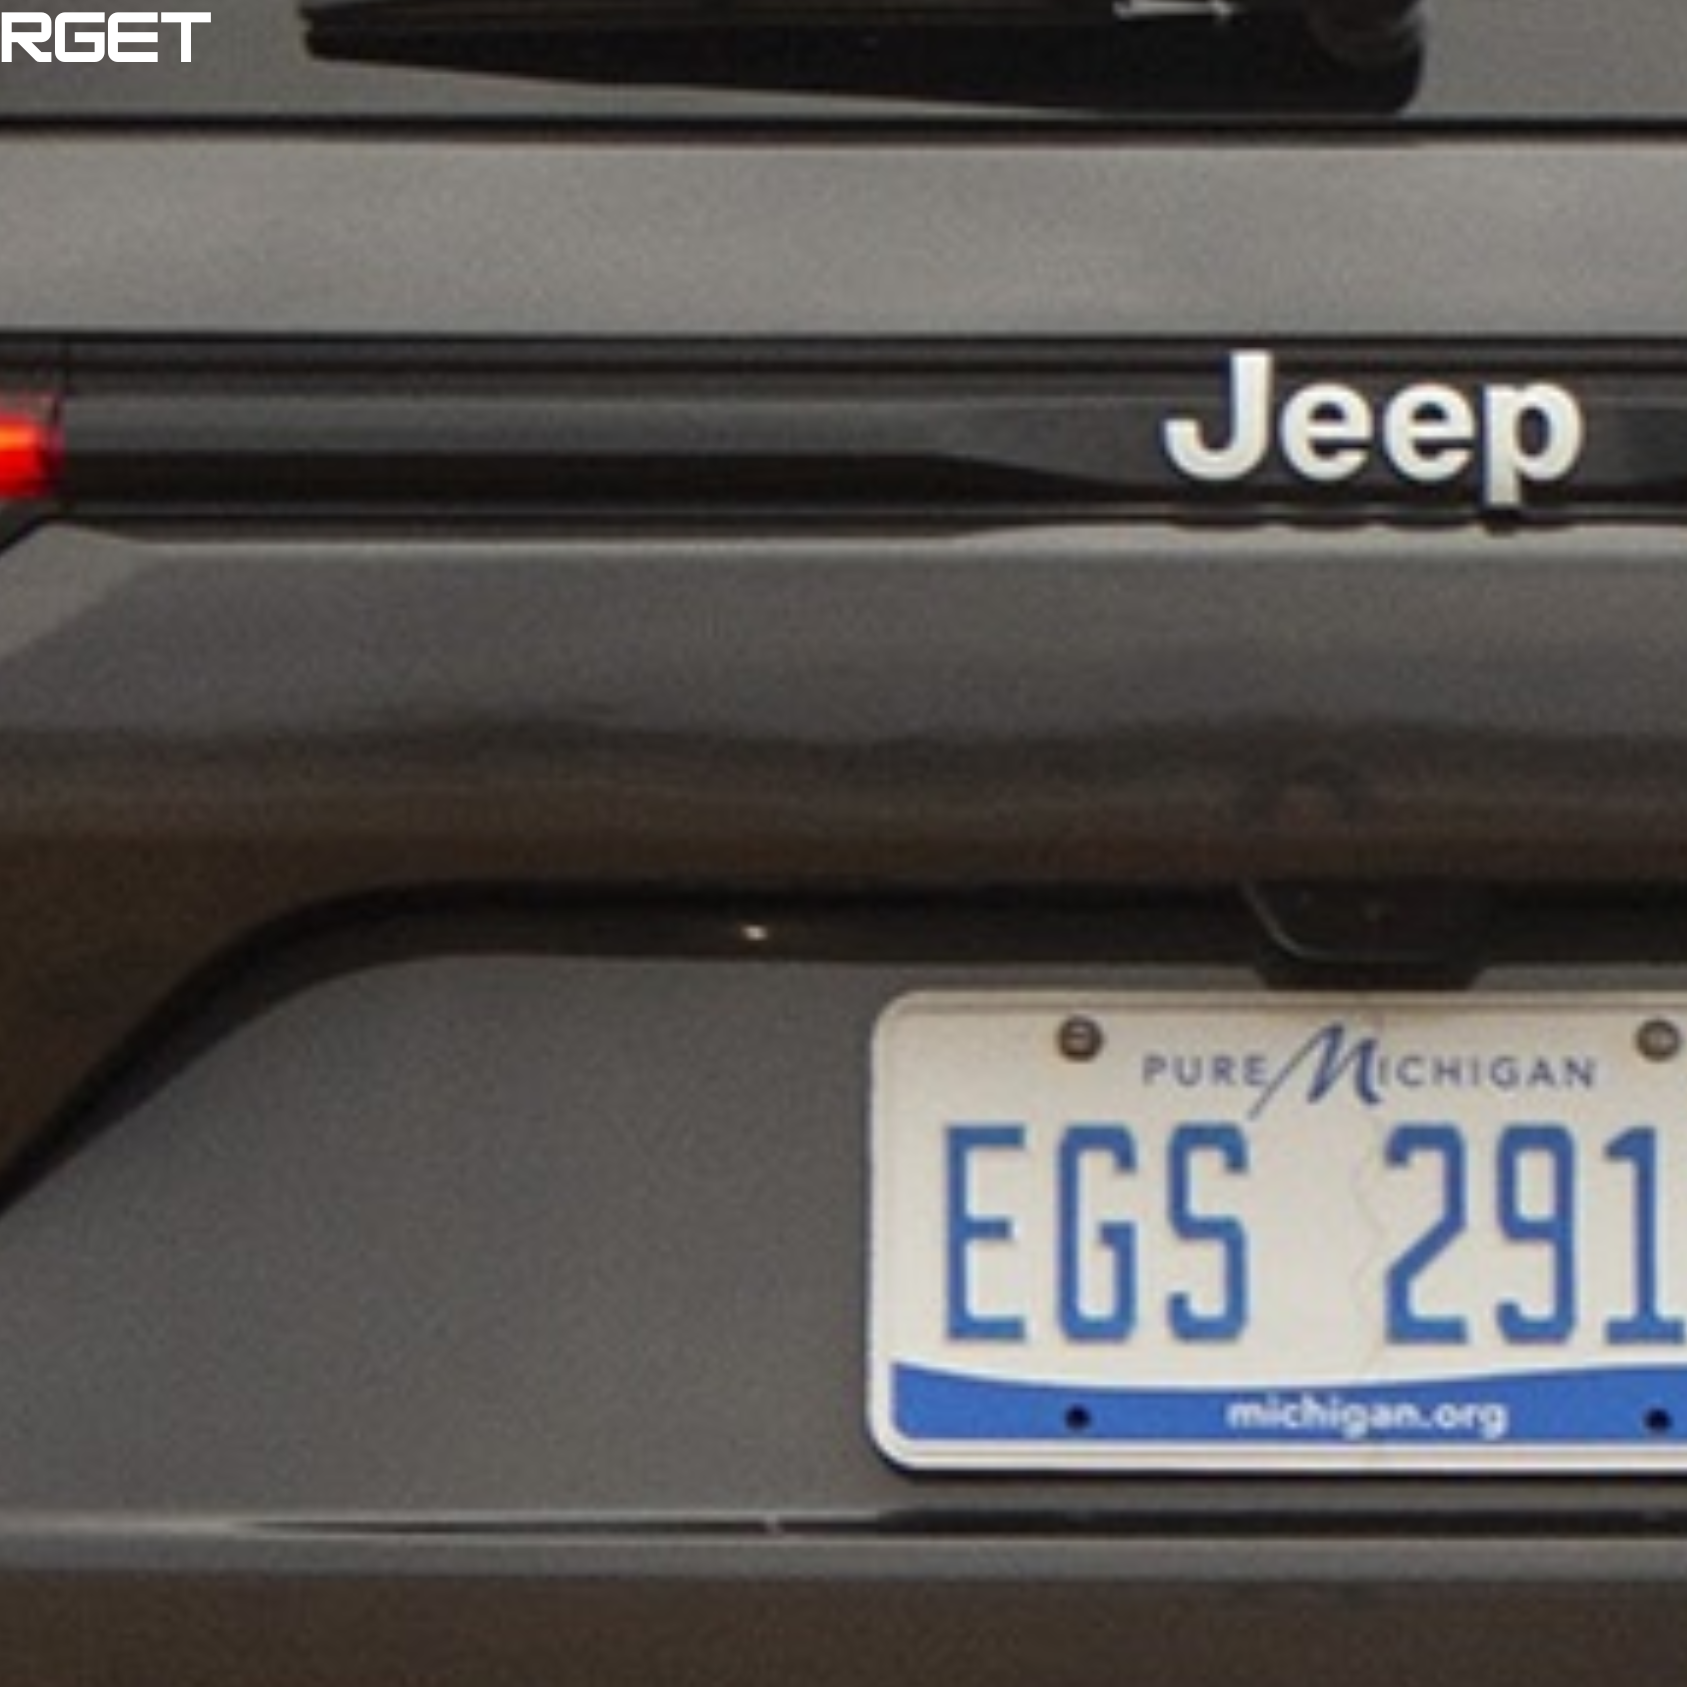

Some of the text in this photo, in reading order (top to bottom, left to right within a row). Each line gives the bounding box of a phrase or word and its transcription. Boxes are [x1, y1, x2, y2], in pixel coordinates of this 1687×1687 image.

[1162, 349, 1584, 505] Jeep
[1142, 1022, 1597, 1119] PURE MICHIGAN
[943, 1123, 1686, 1346] EGS 291
[1226, 1395, 1509, 1440] michigan.org
